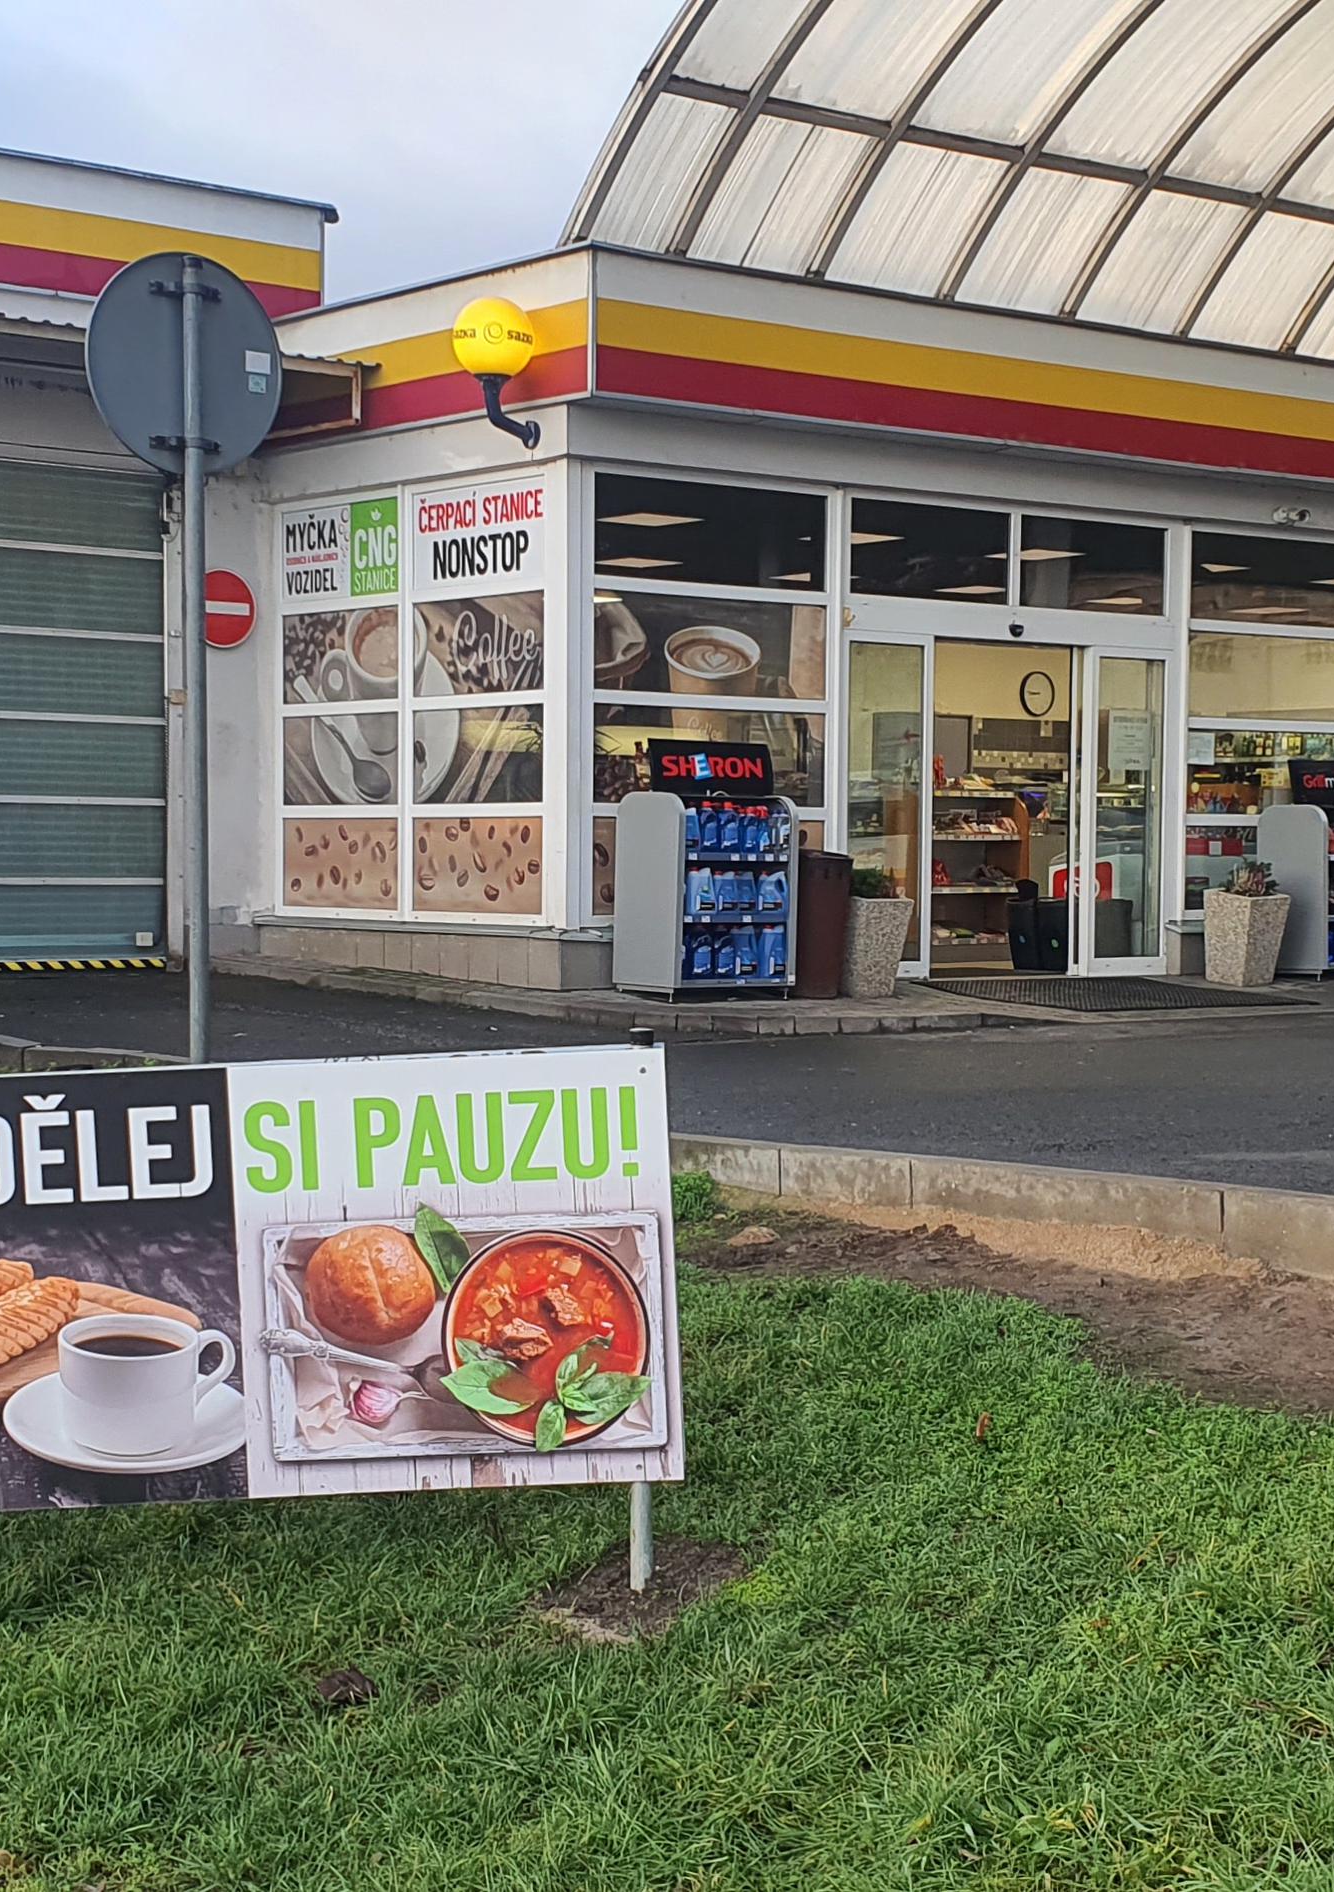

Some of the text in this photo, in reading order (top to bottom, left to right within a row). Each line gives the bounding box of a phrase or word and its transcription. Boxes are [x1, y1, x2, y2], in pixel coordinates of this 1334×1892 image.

[285, 513, 338, 554] MYČKA
[419, 488, 543, 534] ČERPACÍ STANICE
[353, 524, 397, 570] CNG
[432, 530, 529, 581] NONSTOP
[286, 567, 338, 596] VOZIDEL
[354, 567, 396, 593] STANICE
[453, 610, 540, 687] Coffee
[661, 752, 763, 780] SHERON
[243, 1100, 320, 1194] SI
[352, 1086, 640, 1189] PAUZU!
